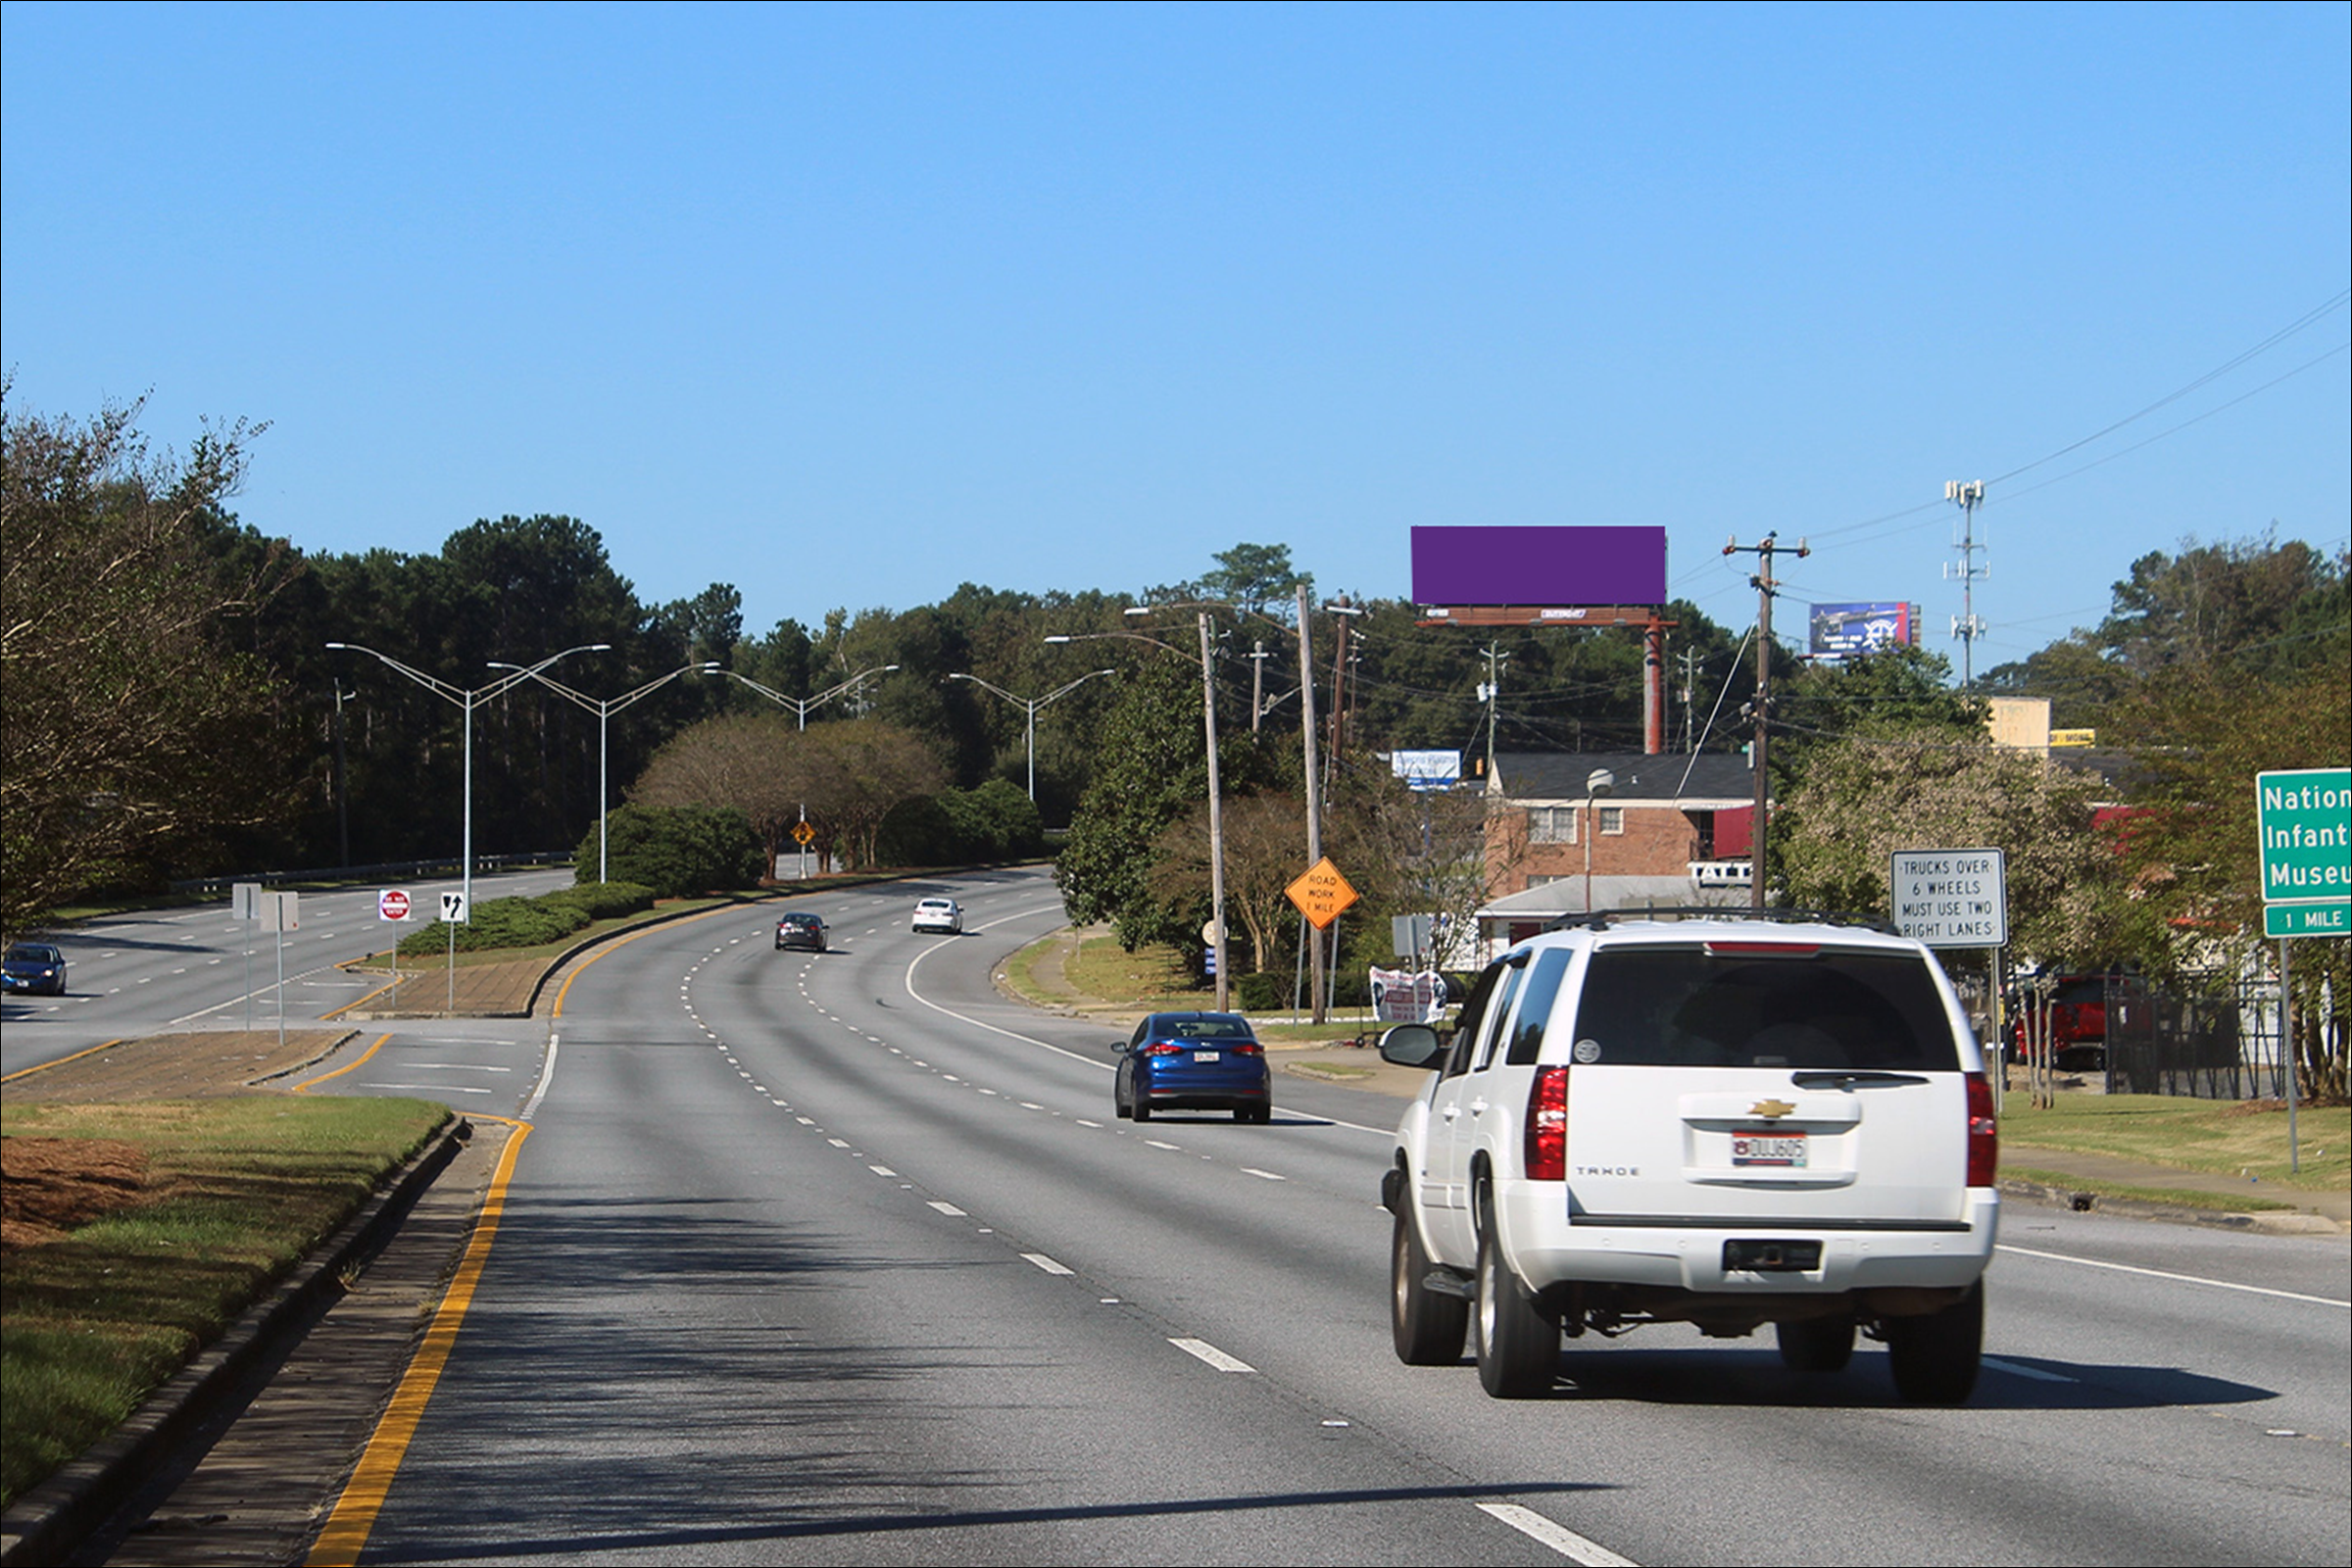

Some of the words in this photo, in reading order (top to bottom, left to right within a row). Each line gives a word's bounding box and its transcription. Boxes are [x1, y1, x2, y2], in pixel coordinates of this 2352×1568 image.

[2265, 785, 2351, 810] Nation
[2267, 822, 2351, 849] Infant
[1687, 861, 1753, 880] TATT
[1904, 860, 1950, 875] TRUCKS
[1956, 859, 1989, 874] OVER
[2271, 862, 2351, 887] Museu
[1308, 874, 1338, 886] ROAD
[1912, 882, 1921, 896] 6
[1928, 880, 1982, 896] WHEELS
[1308, 889, 1336, 900] WORK
[1314, 903, 1335, 912] MILE
[1902, 902, 1933, 916] MUST
[1937, 902, 1961, 916] USE
[1967, 901, 1992, 914] TWO
[2285, 912, 2291, 928] 1
[2305, 910, 2342, 927] MILE
[1903, 923, 1940, 938] RIGHT
[1948, 921, 1992, 936] LANES
[1576, 1166, 1640, 1176] TAHOE
